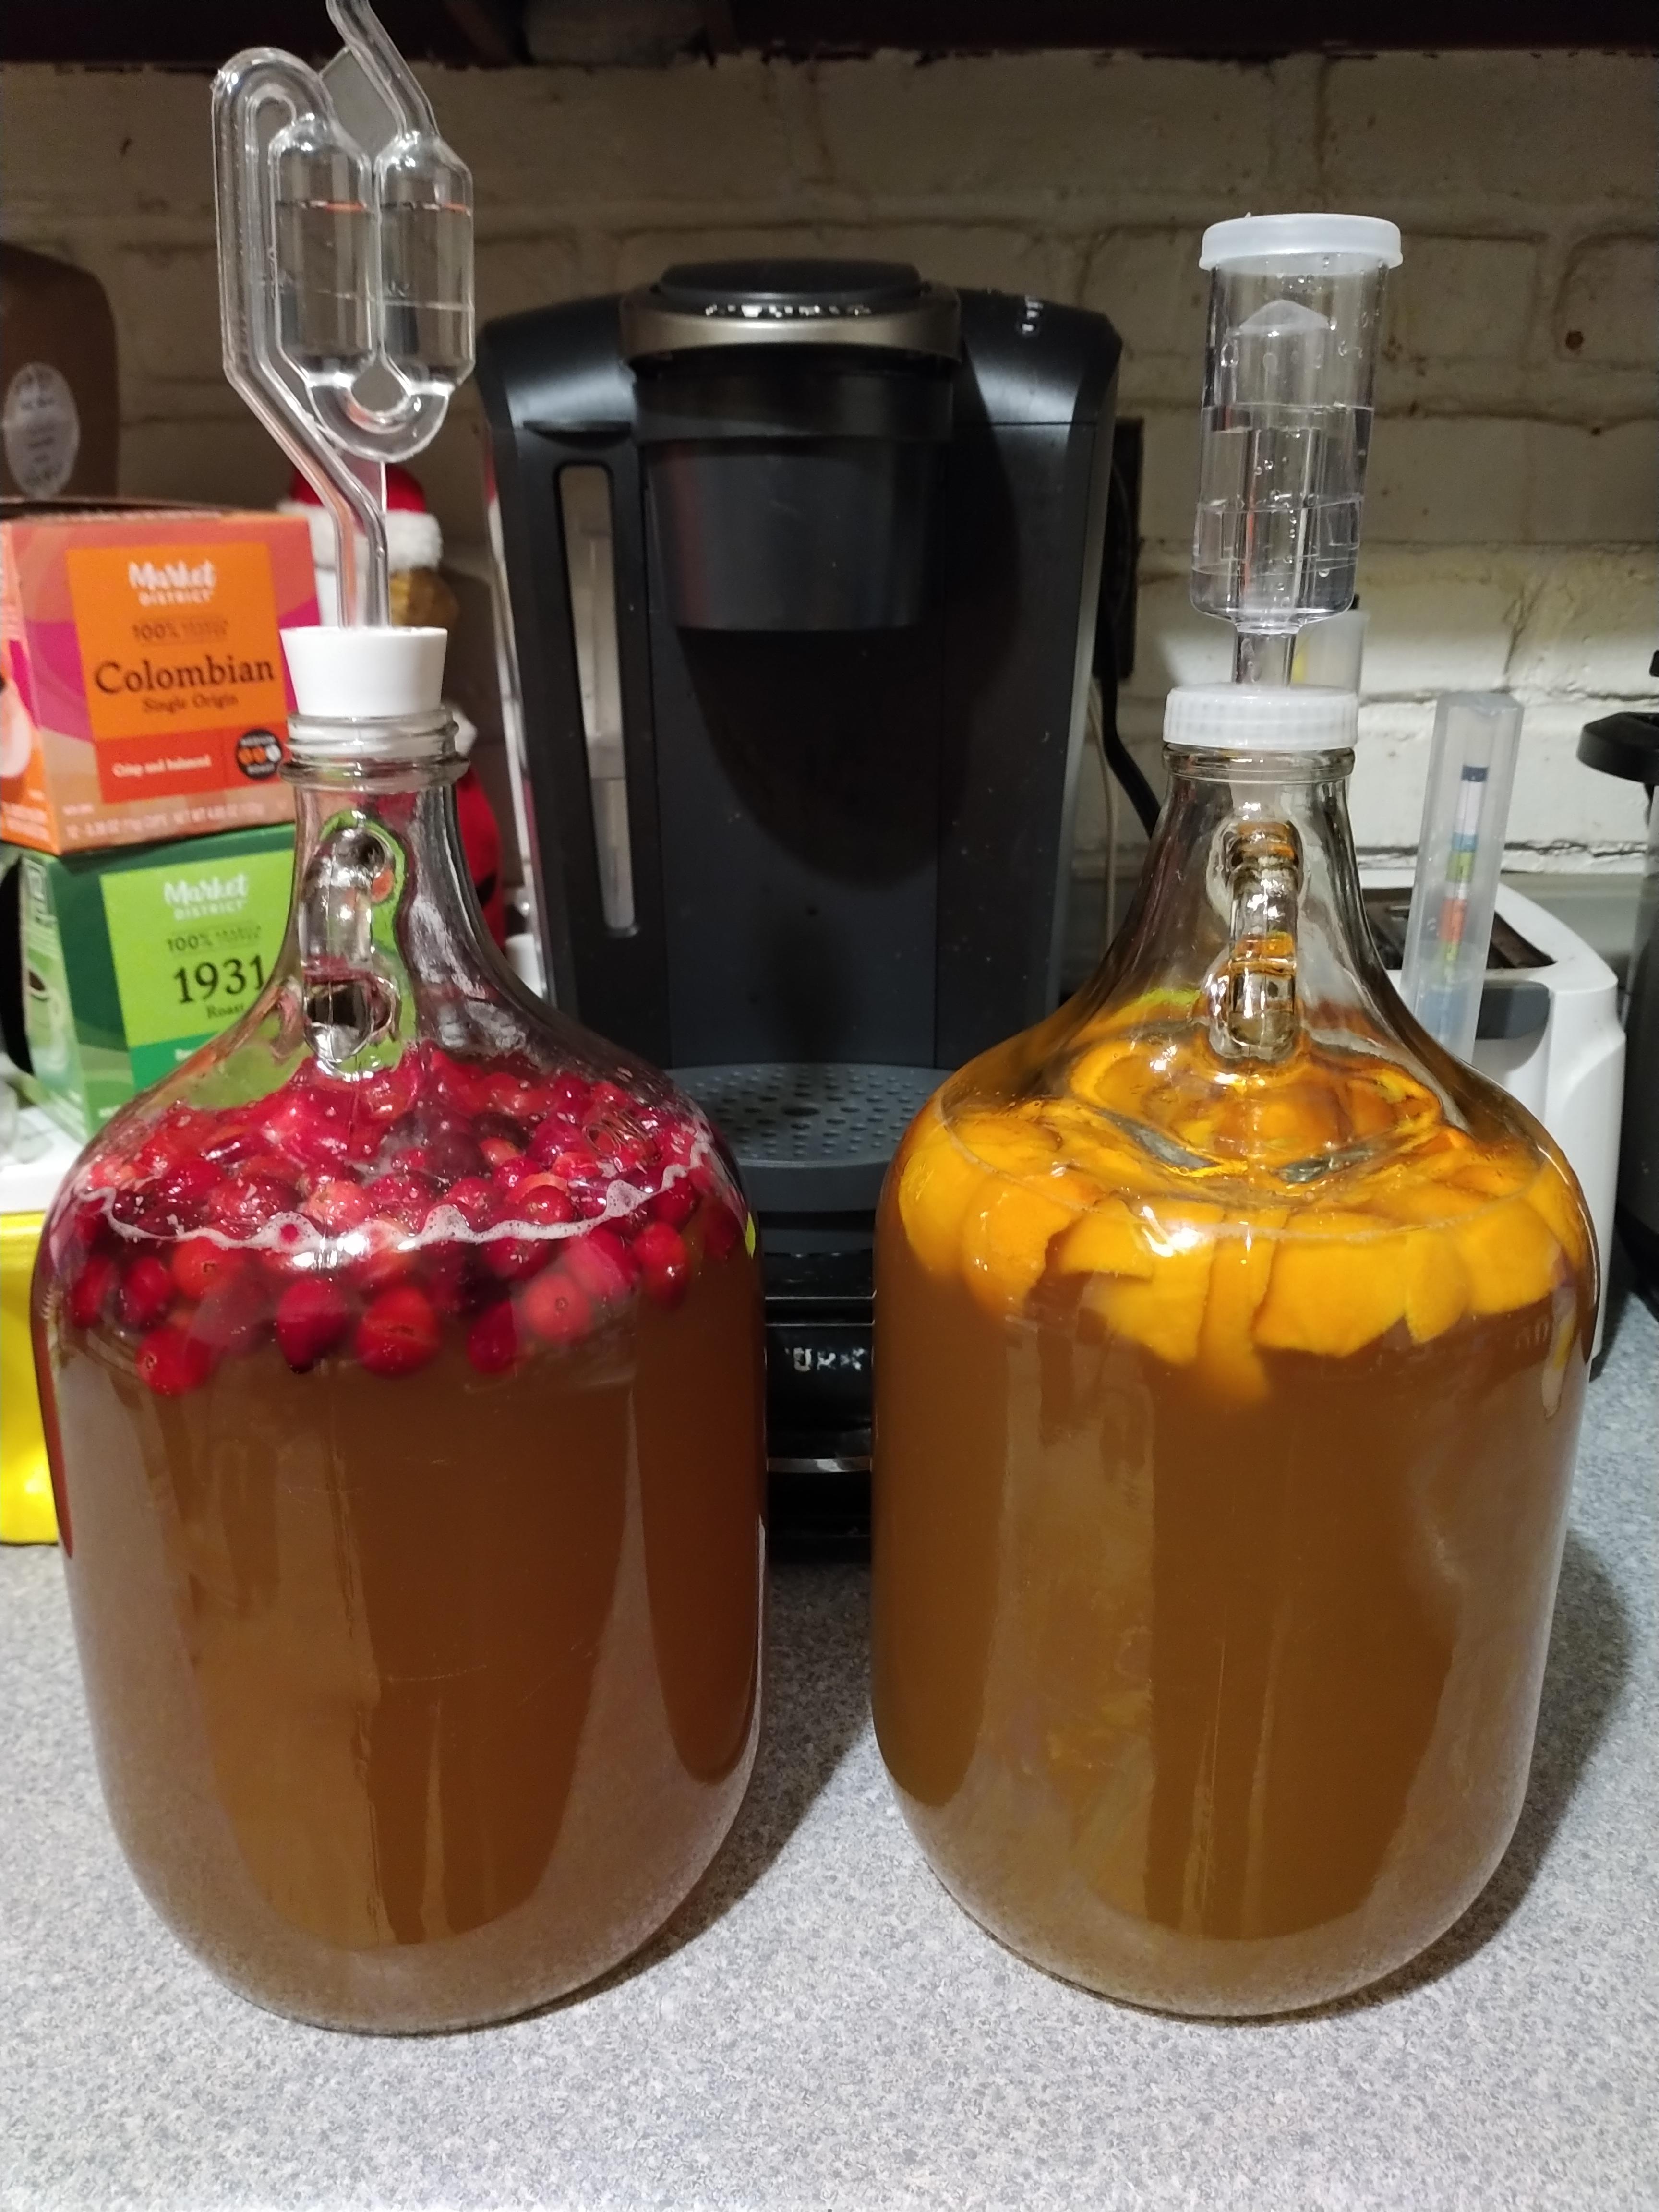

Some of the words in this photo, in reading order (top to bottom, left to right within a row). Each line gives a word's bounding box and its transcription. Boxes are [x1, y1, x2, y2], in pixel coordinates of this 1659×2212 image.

[95, 654, 275, 694] Colombian
[192, 693, 239, 710] Origin
[167, 933, 213, 951] 100%
[174, 954, 264, 1004] 1931
